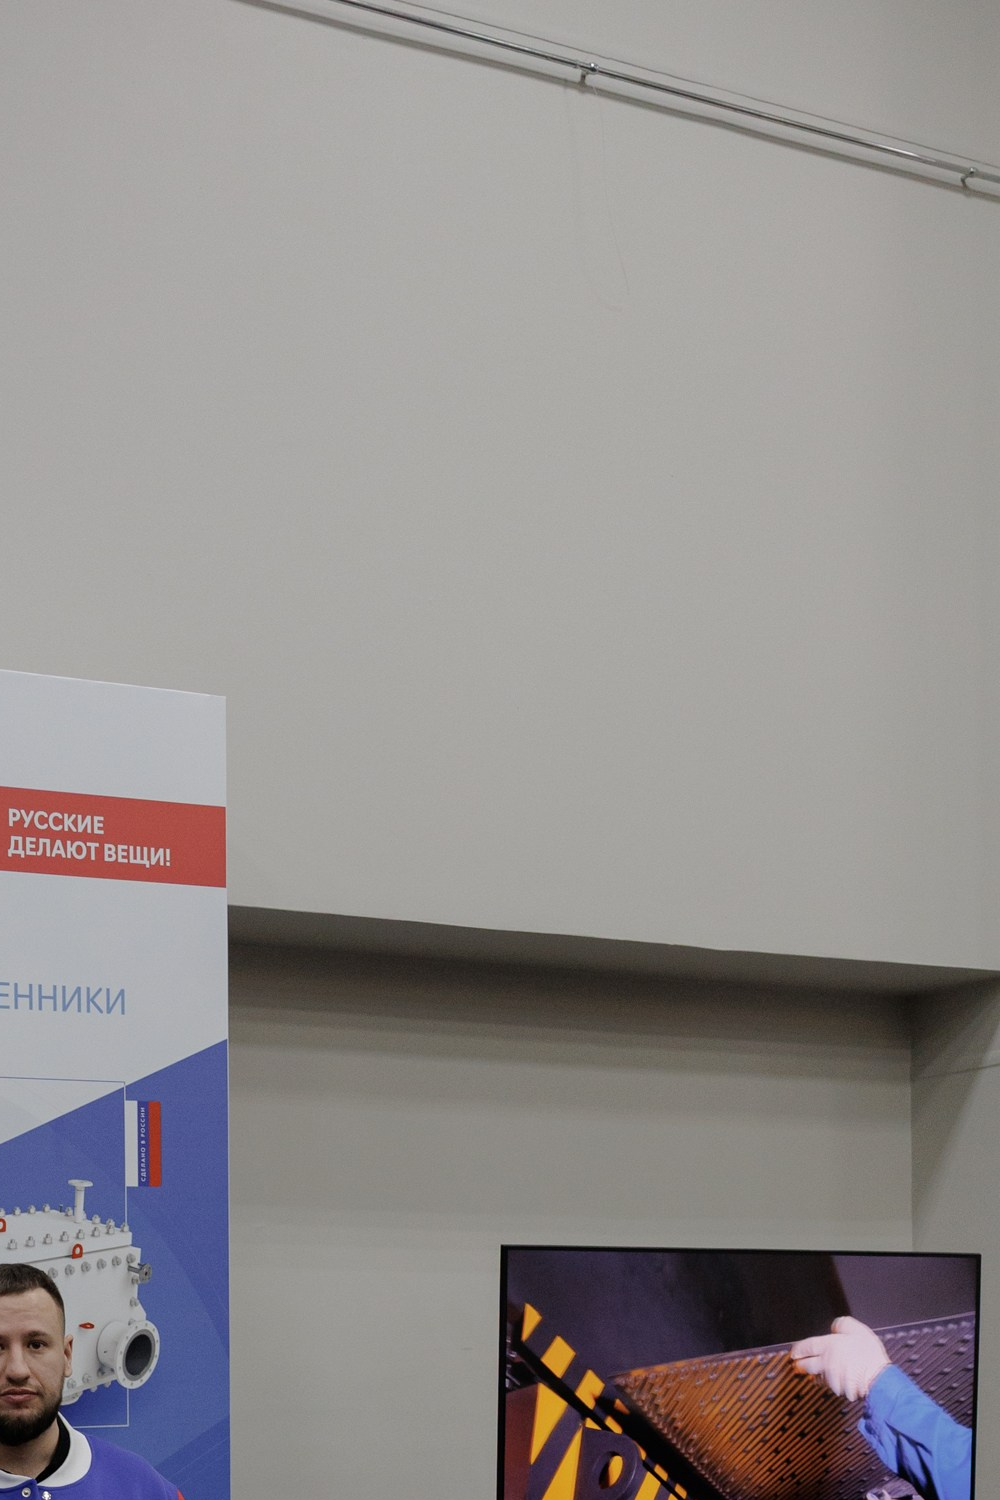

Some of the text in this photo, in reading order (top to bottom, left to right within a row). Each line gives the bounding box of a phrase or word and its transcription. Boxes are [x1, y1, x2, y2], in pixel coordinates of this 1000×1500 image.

[7, 808, 105, 835] РУССКИЕ
[7, 835, 171, 869] ДЕЛАЮТ ВЕЩИ!
